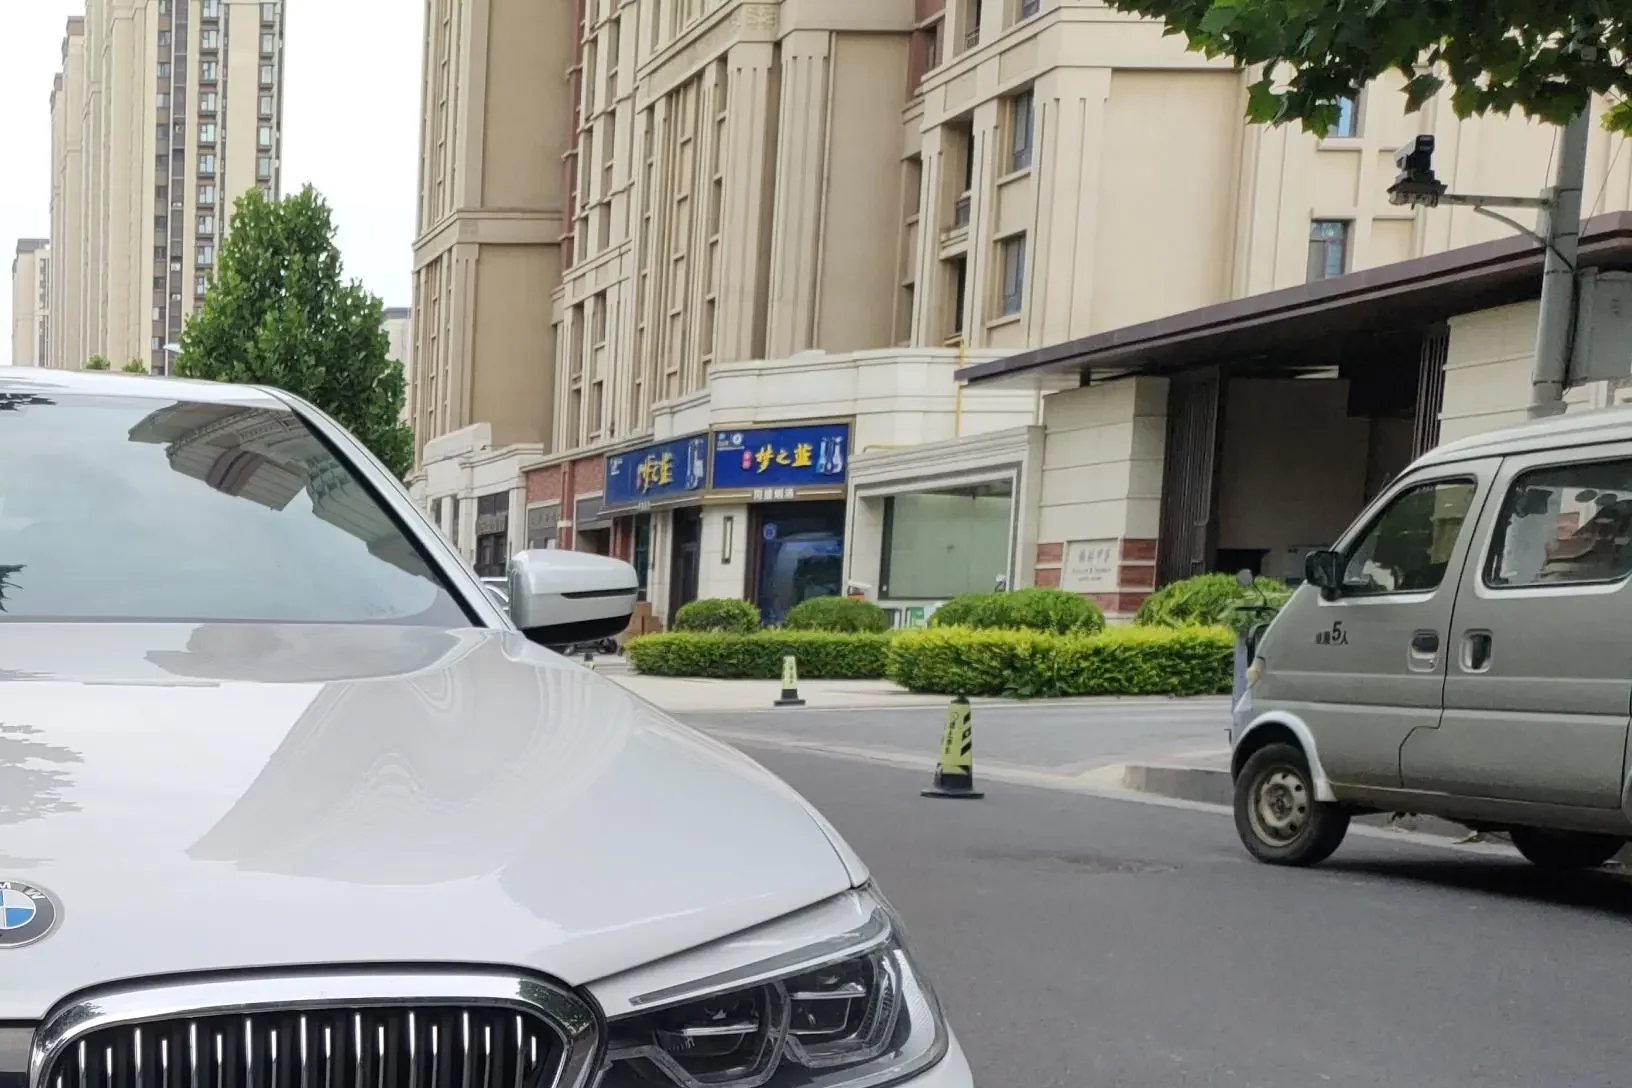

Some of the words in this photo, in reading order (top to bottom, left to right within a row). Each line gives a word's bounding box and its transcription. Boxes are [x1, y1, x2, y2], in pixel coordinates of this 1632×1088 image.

[755, 443, 813, 473] 梦之蓝
[1316, 620, 1348, 645] 5人
